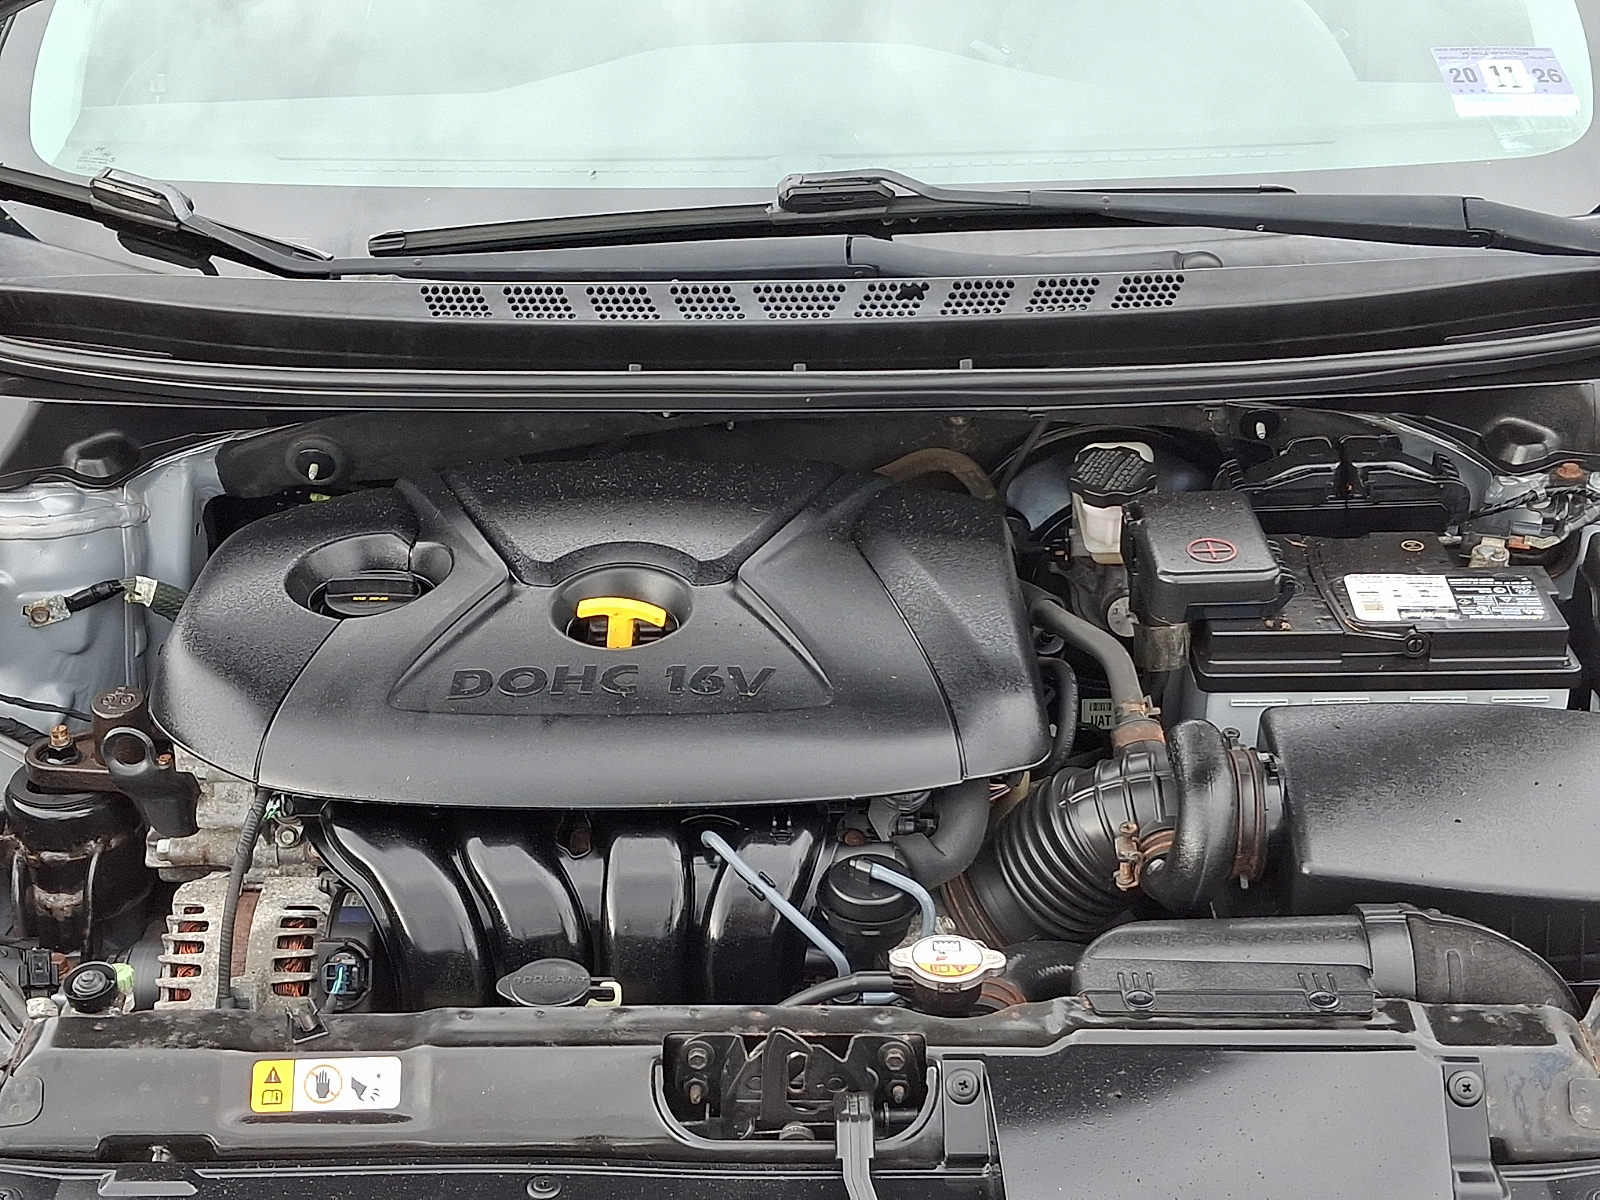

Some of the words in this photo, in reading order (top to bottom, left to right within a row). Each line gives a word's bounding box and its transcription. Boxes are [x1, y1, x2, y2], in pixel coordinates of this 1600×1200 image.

[1448, 67, 1478, 83] 20
[1531, 67, 1563, 83] 26
[445, 663, 639, 700] DOHC
[664, 664, 777, 697] 16V
[512, 974, 588, 985] COOLANT
